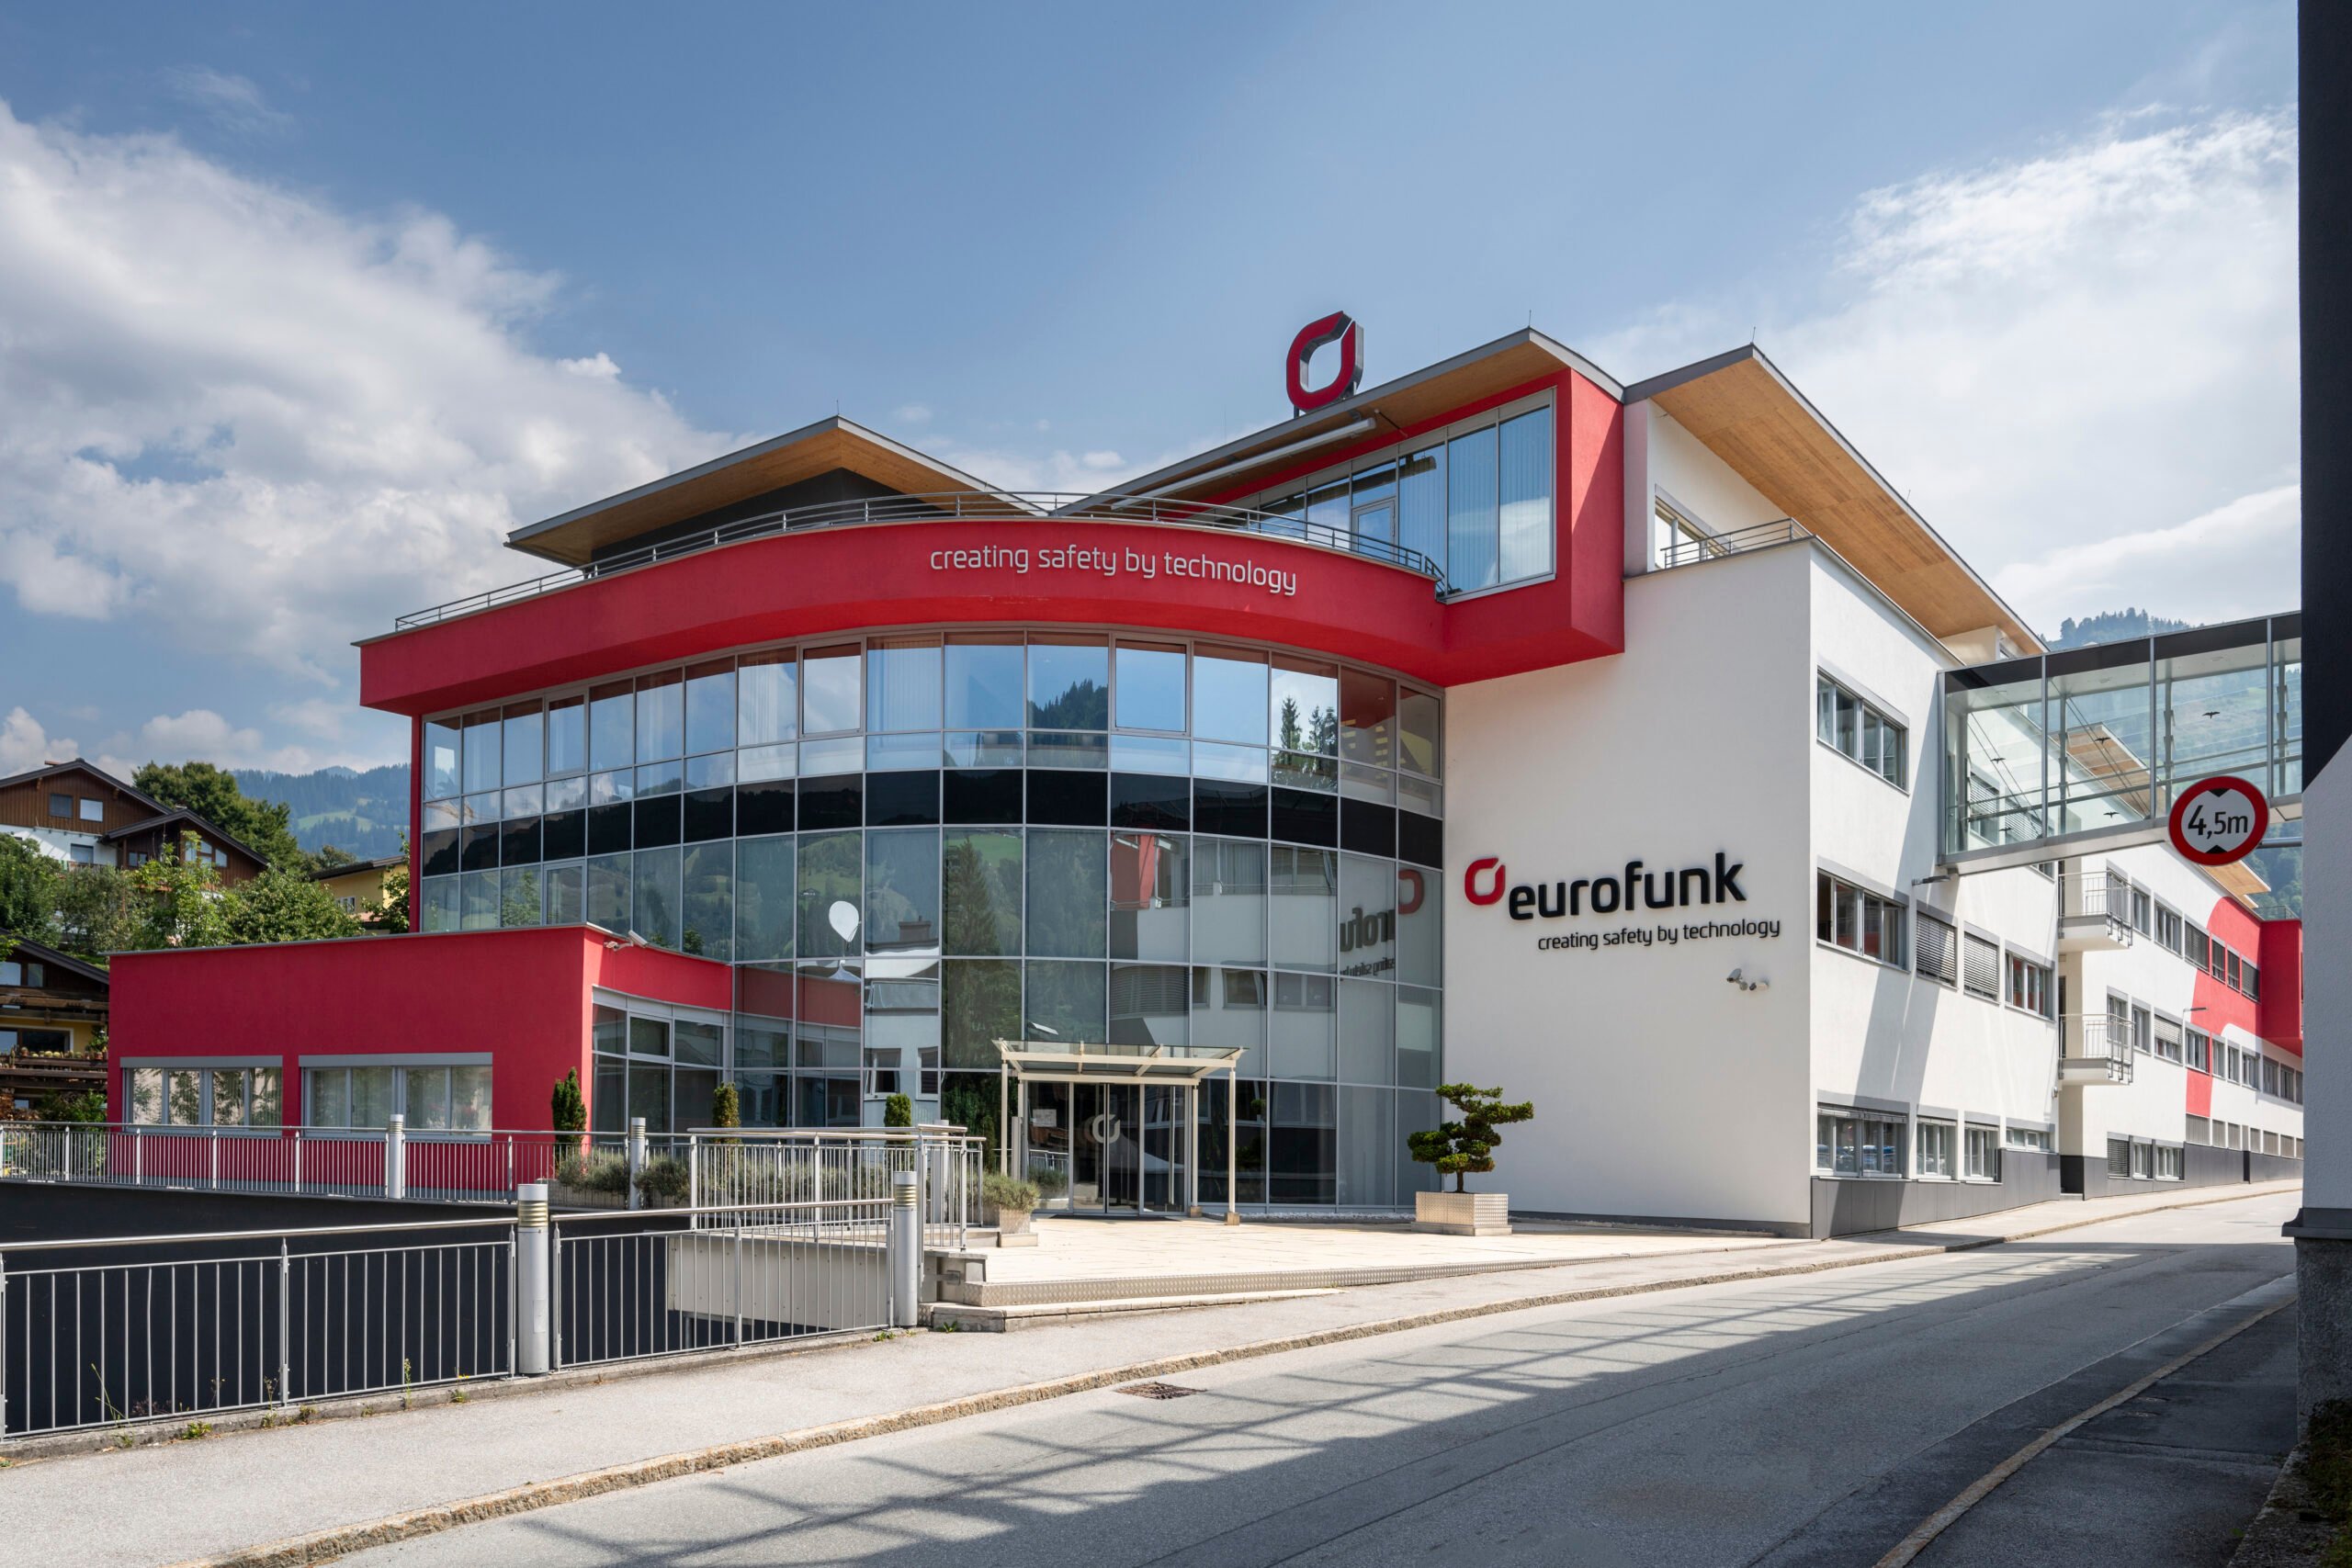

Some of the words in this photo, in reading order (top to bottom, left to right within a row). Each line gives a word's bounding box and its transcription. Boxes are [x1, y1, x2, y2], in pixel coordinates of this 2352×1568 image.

[930, 545, 1029, 574] creating
[1038, 544, 1116, 577] safety
[1125, 547, 1156, 579] by
[1163, 551, 1296, 596] technology
[2188, 805, 2248, 840] 4,5m
[1508, 852, 1747, 920] eurofunk
[1537, 931, 1599, 951] creating
[1602, 927, 1653, 947] safety
[1657, 925, 1679, 945] by
[1682, 918, 1781, 940] technology
